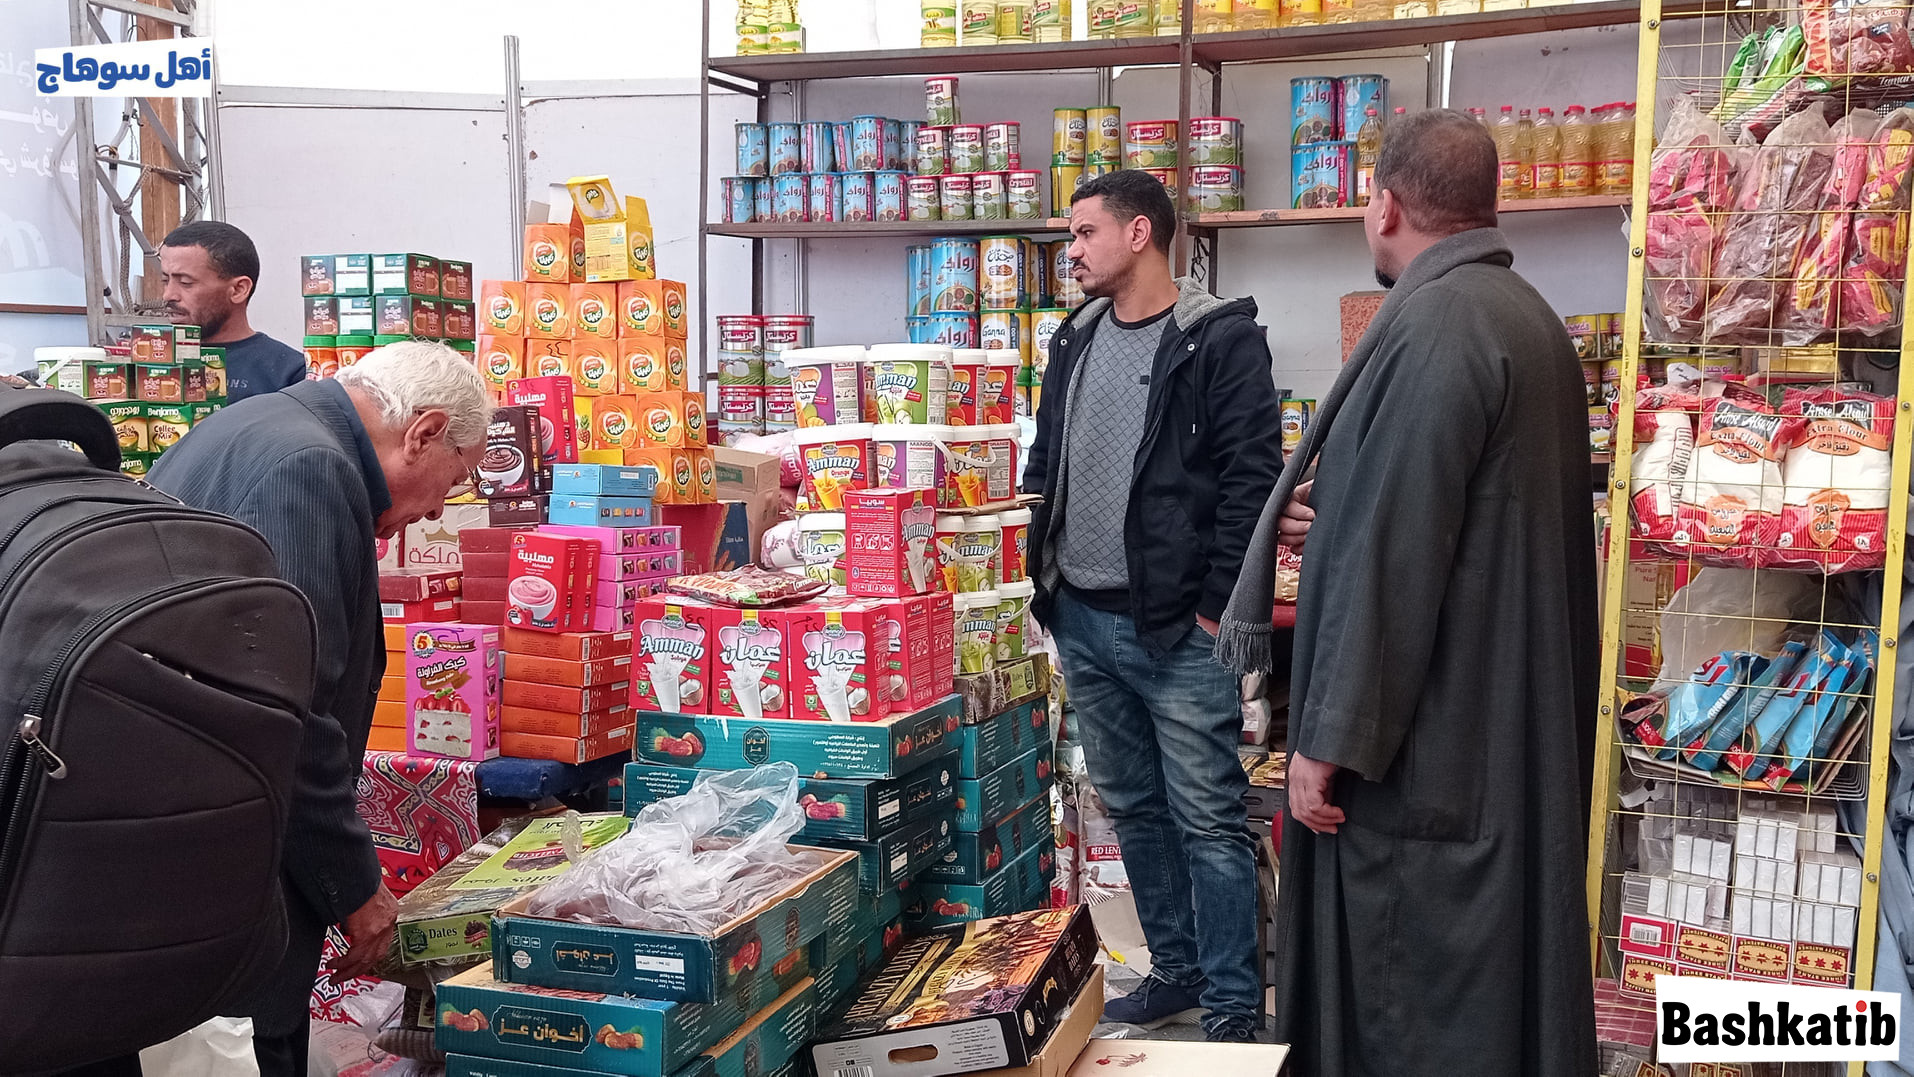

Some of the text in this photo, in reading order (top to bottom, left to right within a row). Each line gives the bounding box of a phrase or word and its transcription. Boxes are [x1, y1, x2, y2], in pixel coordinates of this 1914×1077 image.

[1196, 173, 1231, 186] كريستال
[539, 311, 557, 323] TANG
[585, 311, 603, 323] TANG
[632, 307, 650, 320] TANG
[585, 366, 604, 379] TANG
[633, 363, 652, 376] TANG
[515, 393, 546, 404] مهلبية
[154, 425, 176, 433] Coffee
[1807, 424, 1868, 441] Extra Flour
[1740, 432, 1764, 452] Flour
[1817, 442, 1850, 452] دقيق فاخر
[807, 456, 860, 475] Amman
[901, 523, 935, 547] Amman
[518, 550, 554, 564] مهلبية
[418, 635, 427, 649] 5
[638, 635, 704, 660] Amman
[719, 637, 781, 664] عمان
[804, 641, 866, 670] عمان
[417, 656, 466, 678] كيك الفراولة
[1091, 847, 1104, 855] RED
[428, 926, 458, 939] Dates
[1628, 958, 1650, 967] THREE
[1680, 953, 1724, 967] THREE STARS
[1682, 970, 1704, 978] THREE
[1739, 965, 1760, 974] STARS
[1797, 970, 1819, 980] STARS
[843, 976, 905, 1019] HEGAZY
[882, 941, 931, 981] DATES
[498, 1017, 584, 1043] أخوان عز
